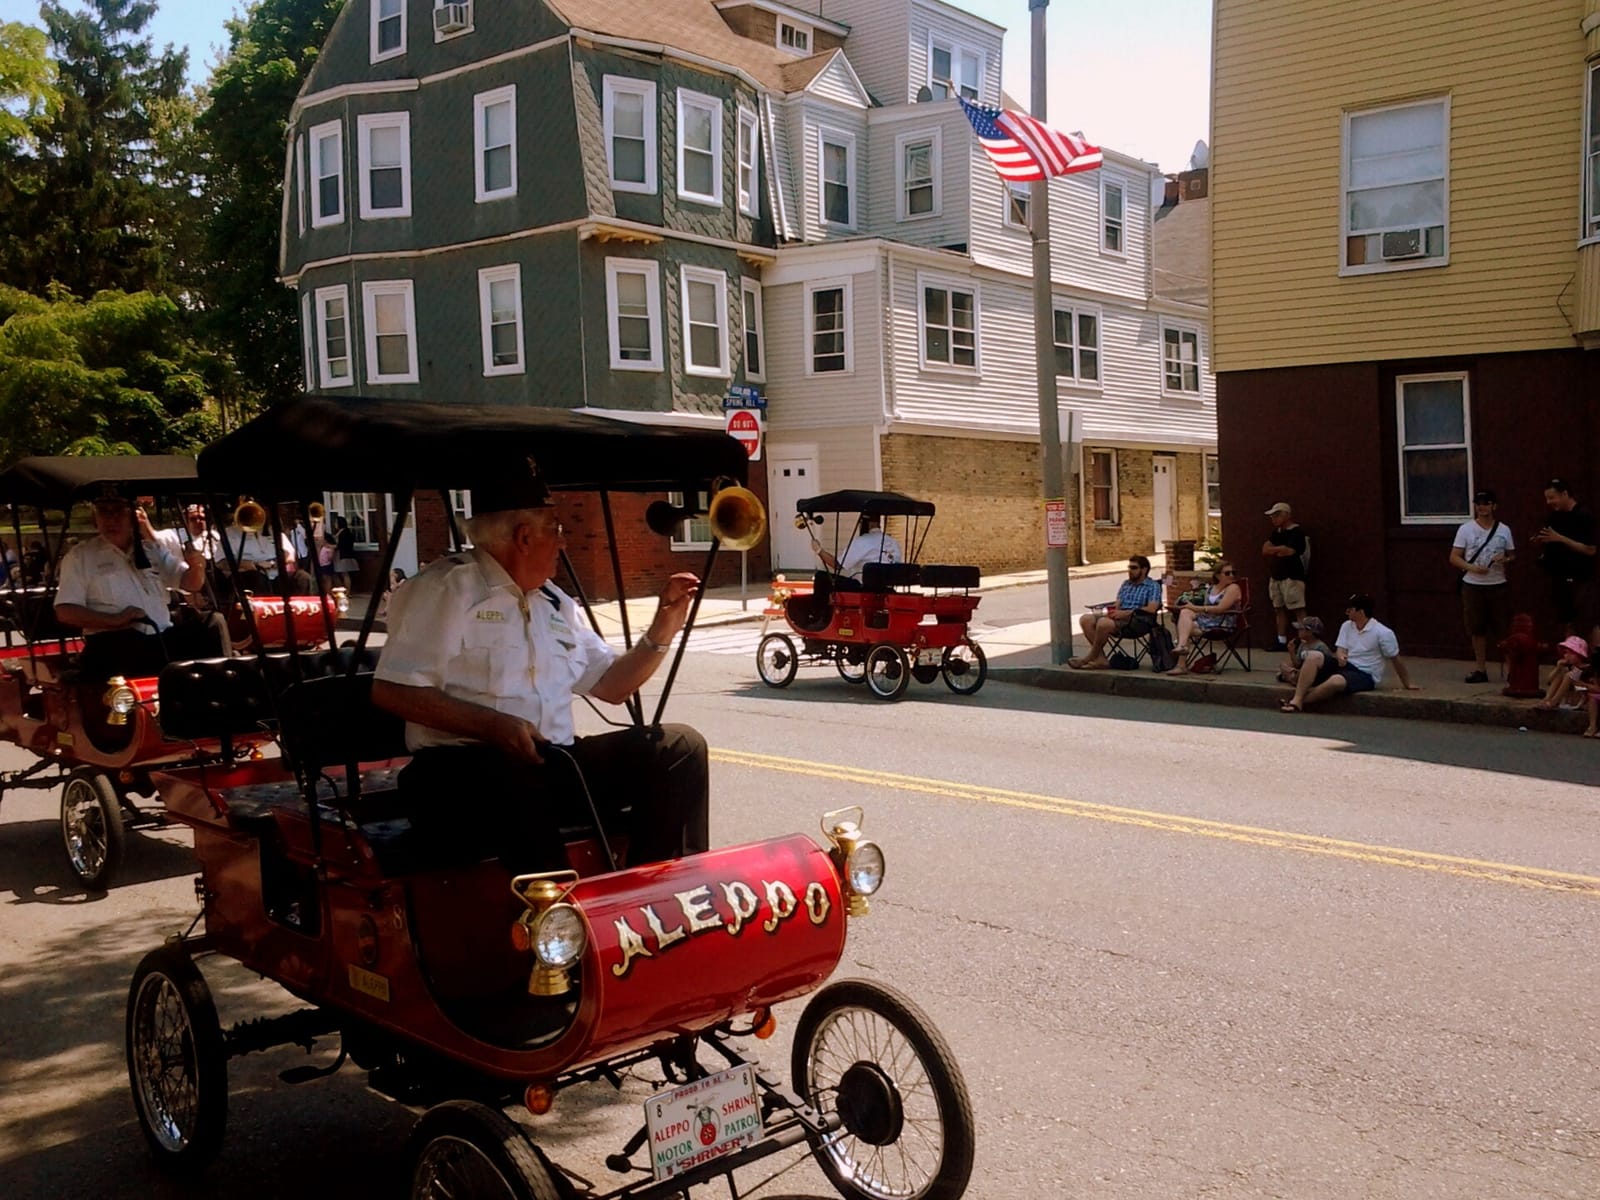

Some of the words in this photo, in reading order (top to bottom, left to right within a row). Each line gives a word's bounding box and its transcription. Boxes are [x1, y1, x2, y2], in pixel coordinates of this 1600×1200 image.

[733, 420, 741, 429] DO
[742, 420, 754, 429] NOT
[612, 879, 831, 977] ALEPPO
[674, 1084, 698, 1099] PROUD
[701, 1080, 711, 1090] TO
[654, 1119, 690, 1144] ALEPPO
[656, 1140, 693, 1165] MOTOR
[724, 1113, 760, 1137] PATROL
